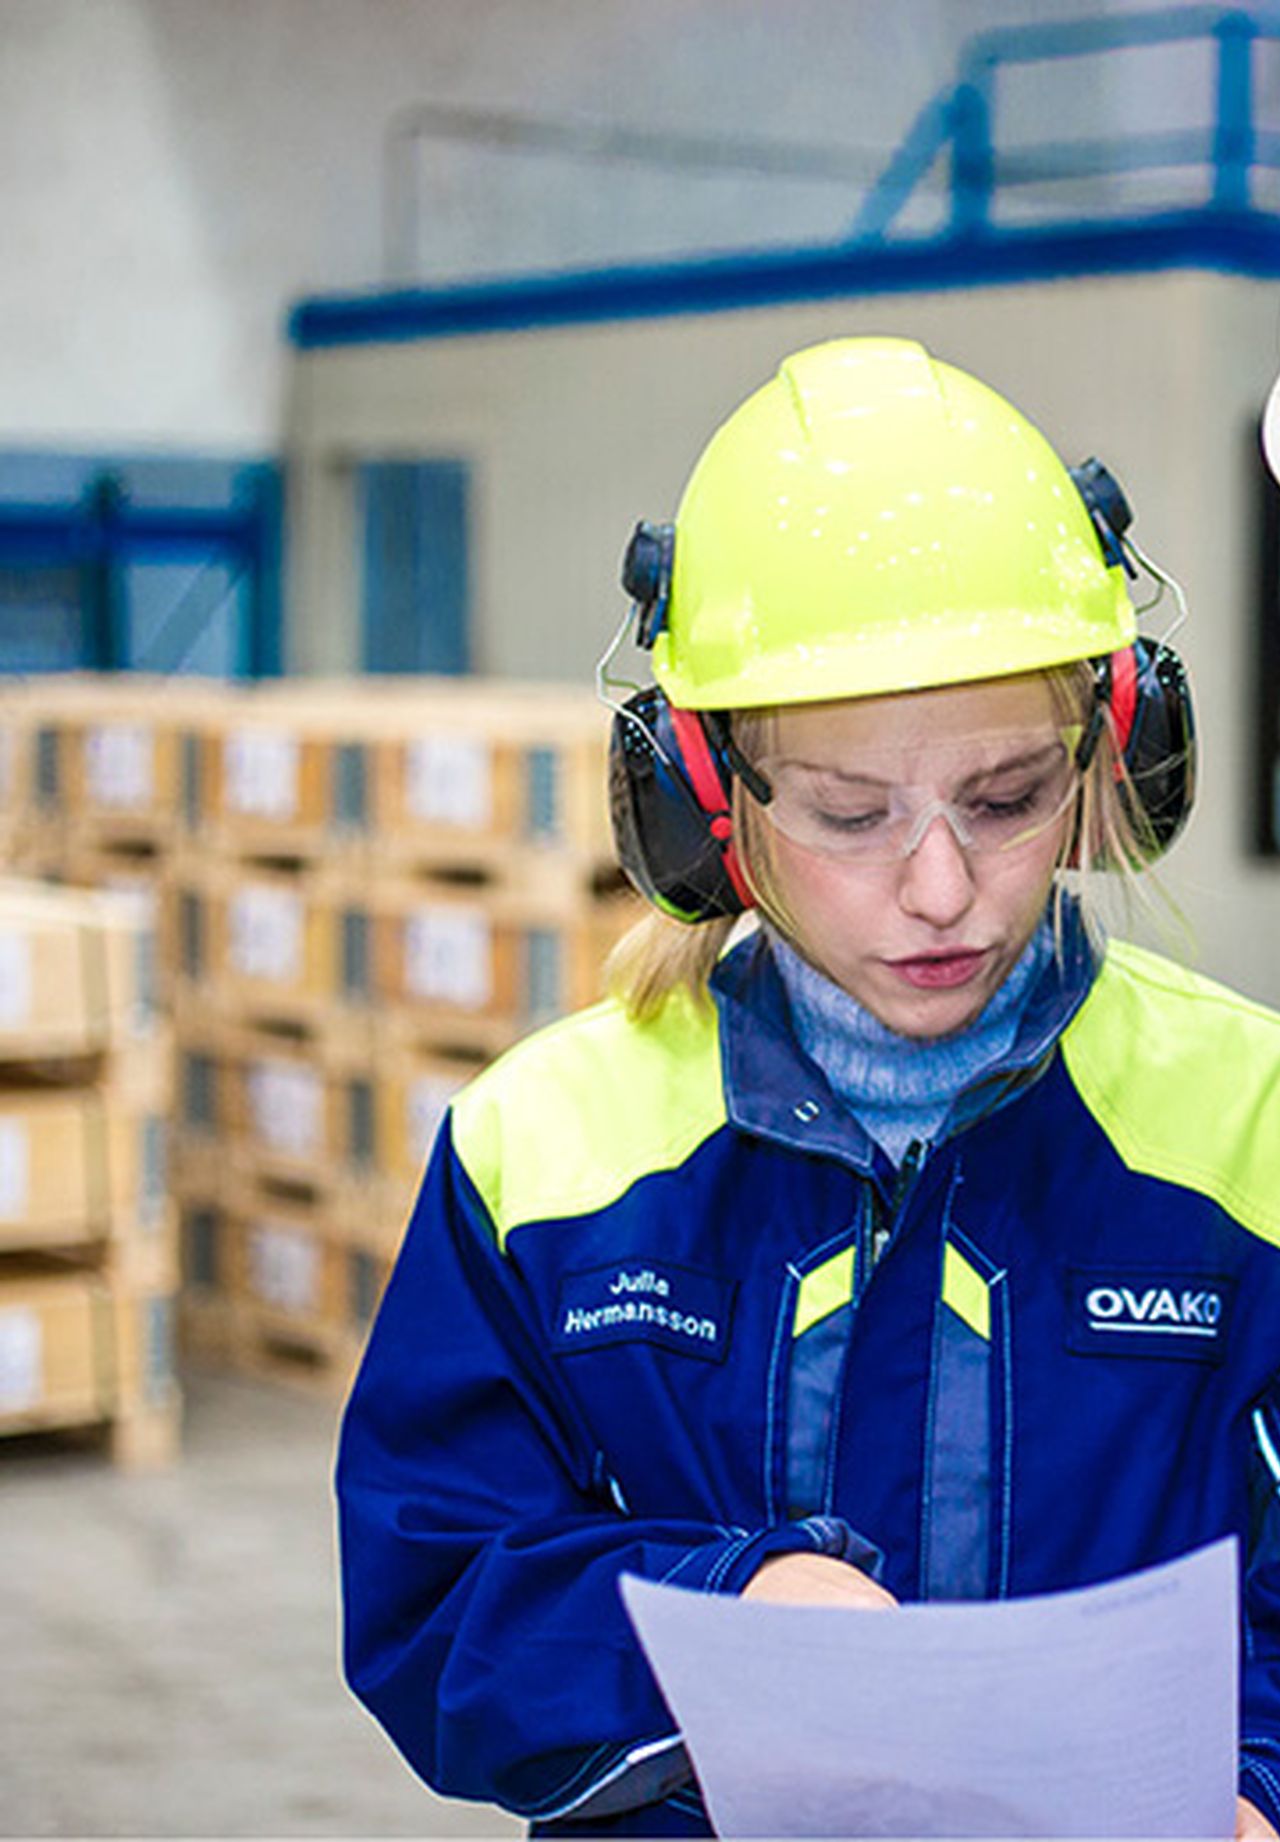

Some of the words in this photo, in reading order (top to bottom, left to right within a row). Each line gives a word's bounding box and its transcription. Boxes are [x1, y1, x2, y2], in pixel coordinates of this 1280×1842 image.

[609, 1269, 669, 1296] Julia
[564, 1301, 717, 1341] Hermansson
[1086, 1287, 1221, 1324] OVAKO
